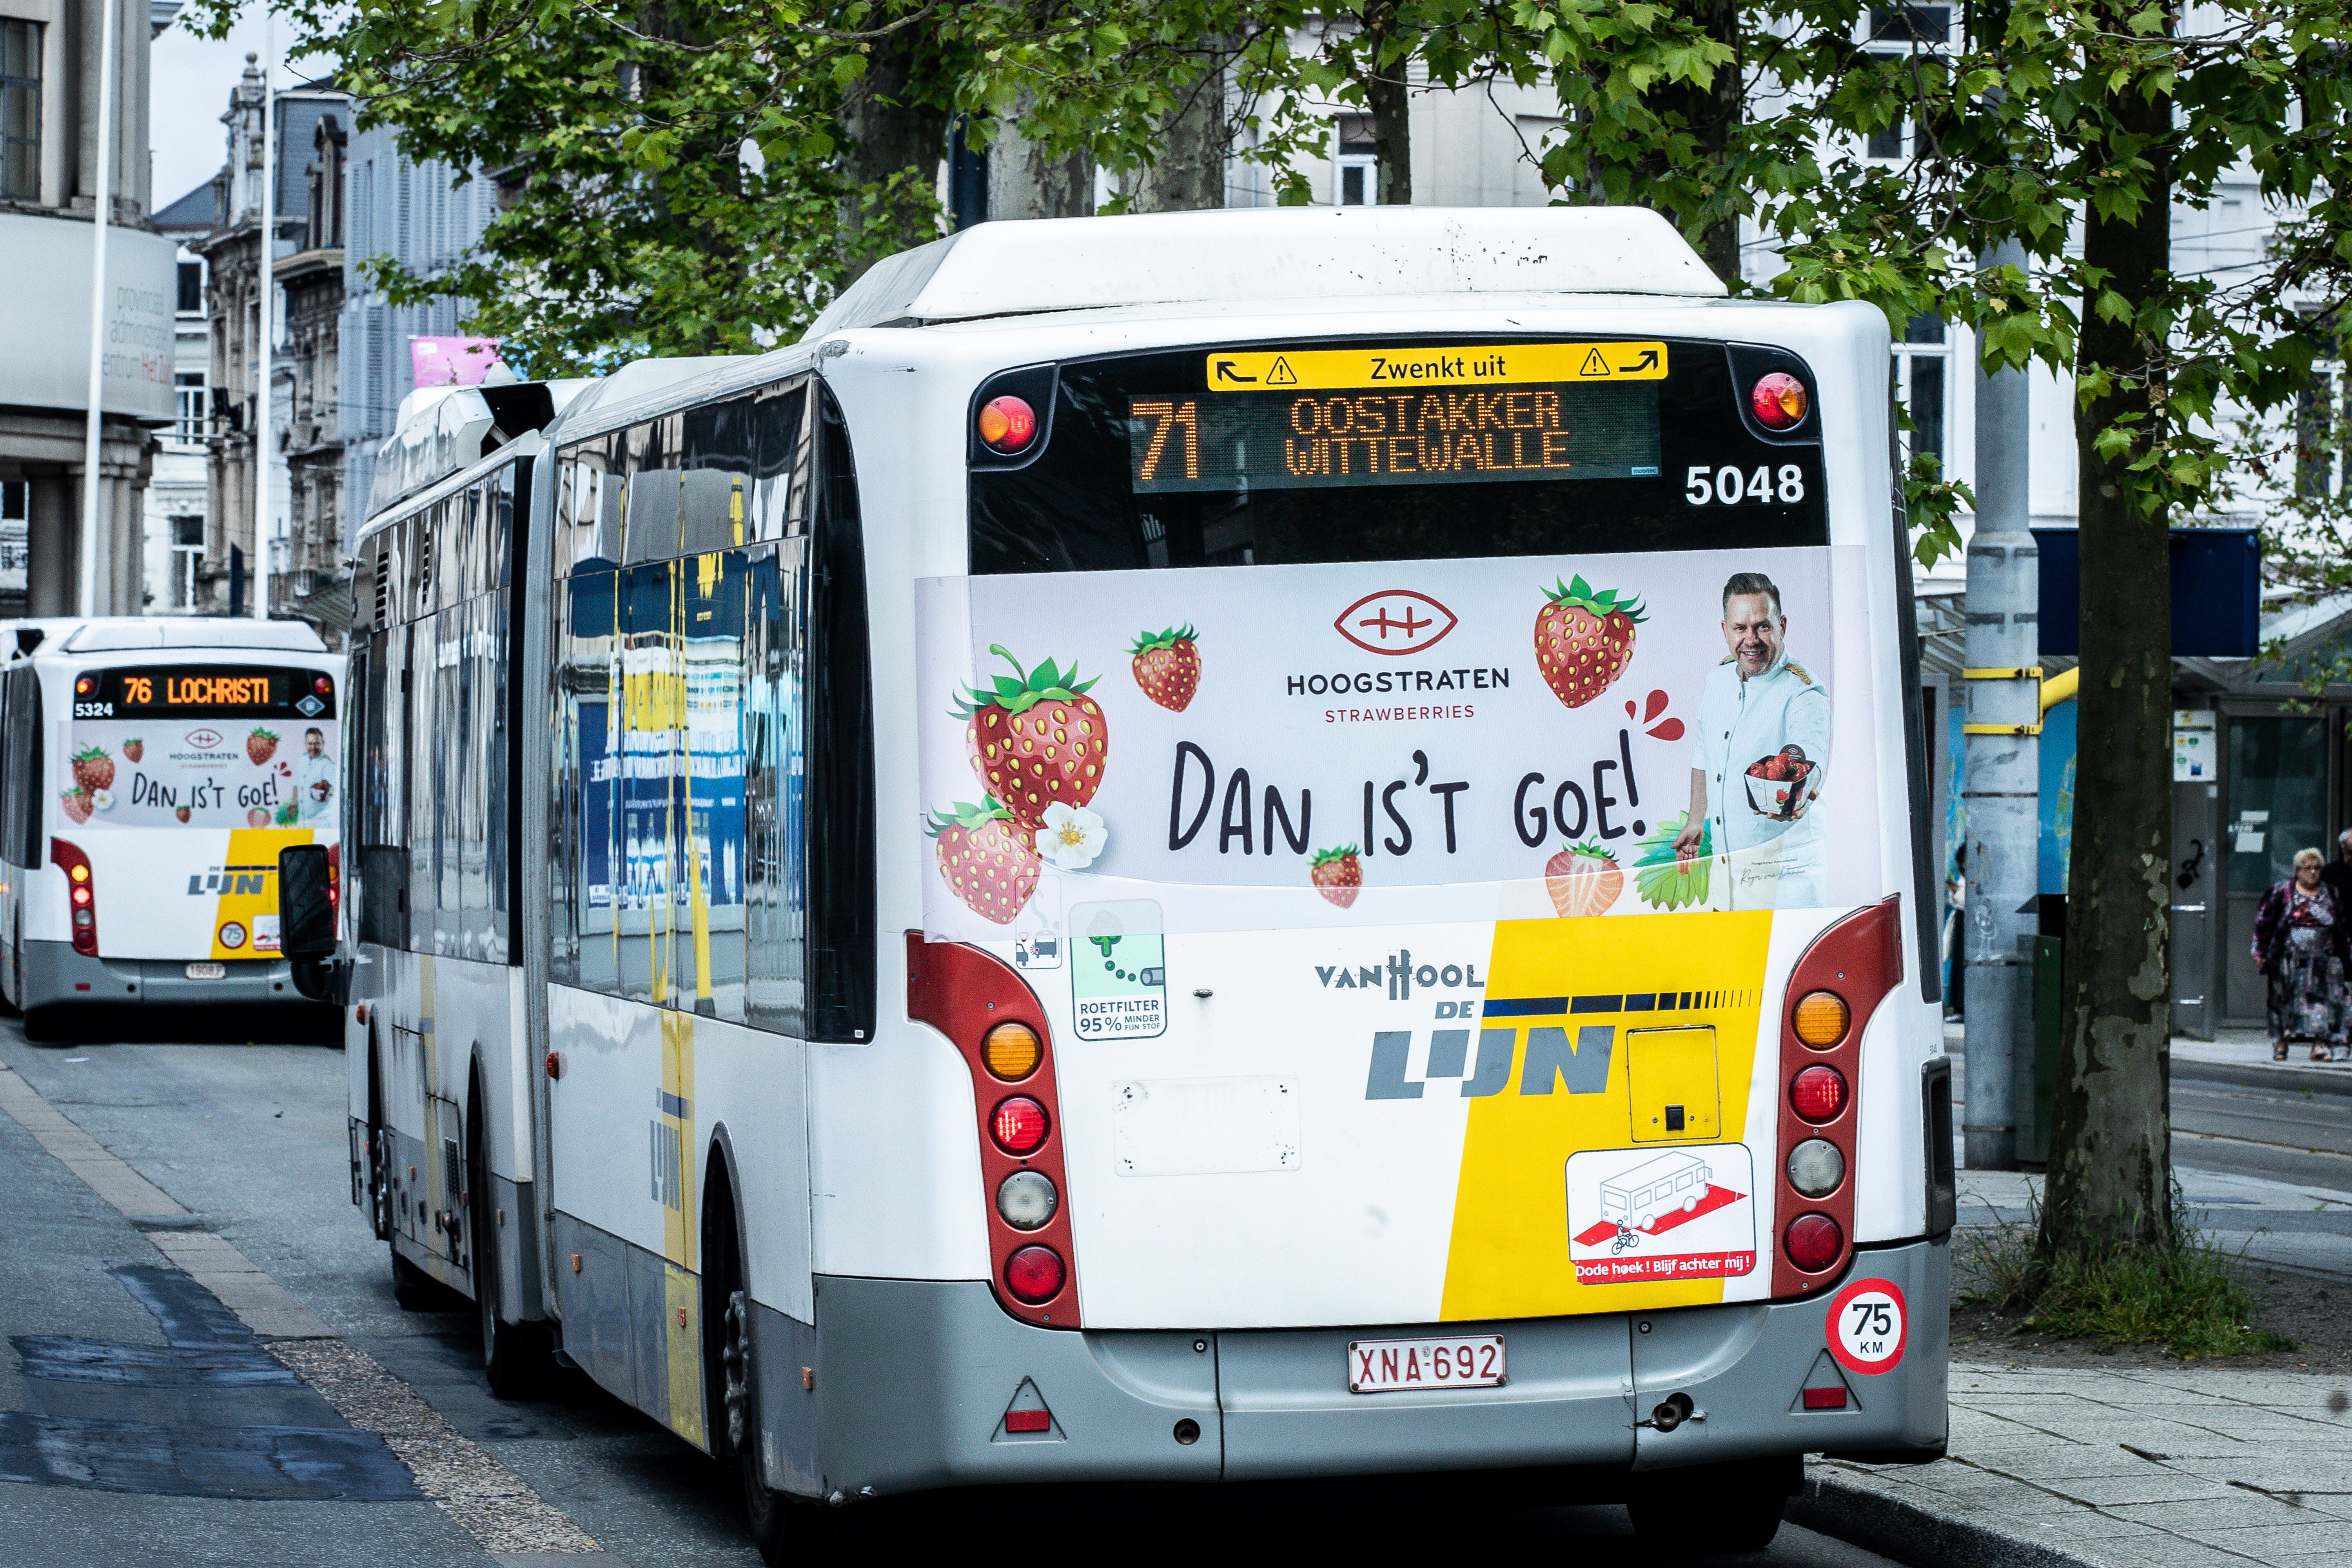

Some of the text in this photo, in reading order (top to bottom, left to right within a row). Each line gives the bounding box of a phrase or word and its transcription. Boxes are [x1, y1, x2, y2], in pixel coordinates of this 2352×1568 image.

[1371, 355, 1506, 379] Zwenkt uit
[1290, 391, 1560, 436] OOSTAKKER
[1131, 401, 1198, 481] 71
[1286, 430, 1571, 477] WITTEWALLE
[1685, 465, 1804, 505] 5048
[124, 677, 269, 704] 76 LOCHRISTI
[1287, 667, 1509, 696] HOOGSTRATEN
[75, 702, 114, 717] 5324
[1325, 705, 1475, 724] STRAWBERRIES
[170, 752, 239, 760] HOOGSTRATEN
[132, 772, 177, 807] DAN
[238, 773, 279, 808] GOE!
[1169, 741, 1311, 856] DAN
[1514, 729, 1646, 849] GOE!
[187, 874, 265, 895] LIJN
[225, 927, 242, 941] 75
[1080, 999, 1159, 1014] ROETFILTER
[1435, 1001, 1475, 1019] DE
[1080, 1014, 1160, 1033] 95% MINDER
[1365, 1025, 1616, 1100] LIJN
[1575, 1265, 1609, 1277] Dode
[1653, 1260, 1678, 1276] Blijf
[1679, 1257, 1722, 1271] achter
[1853, 1303, 1891, 1335] 75
[1860, 1341, 1883, 1354] KM
[1357, 1344, 1498, 1385] XNA-692
